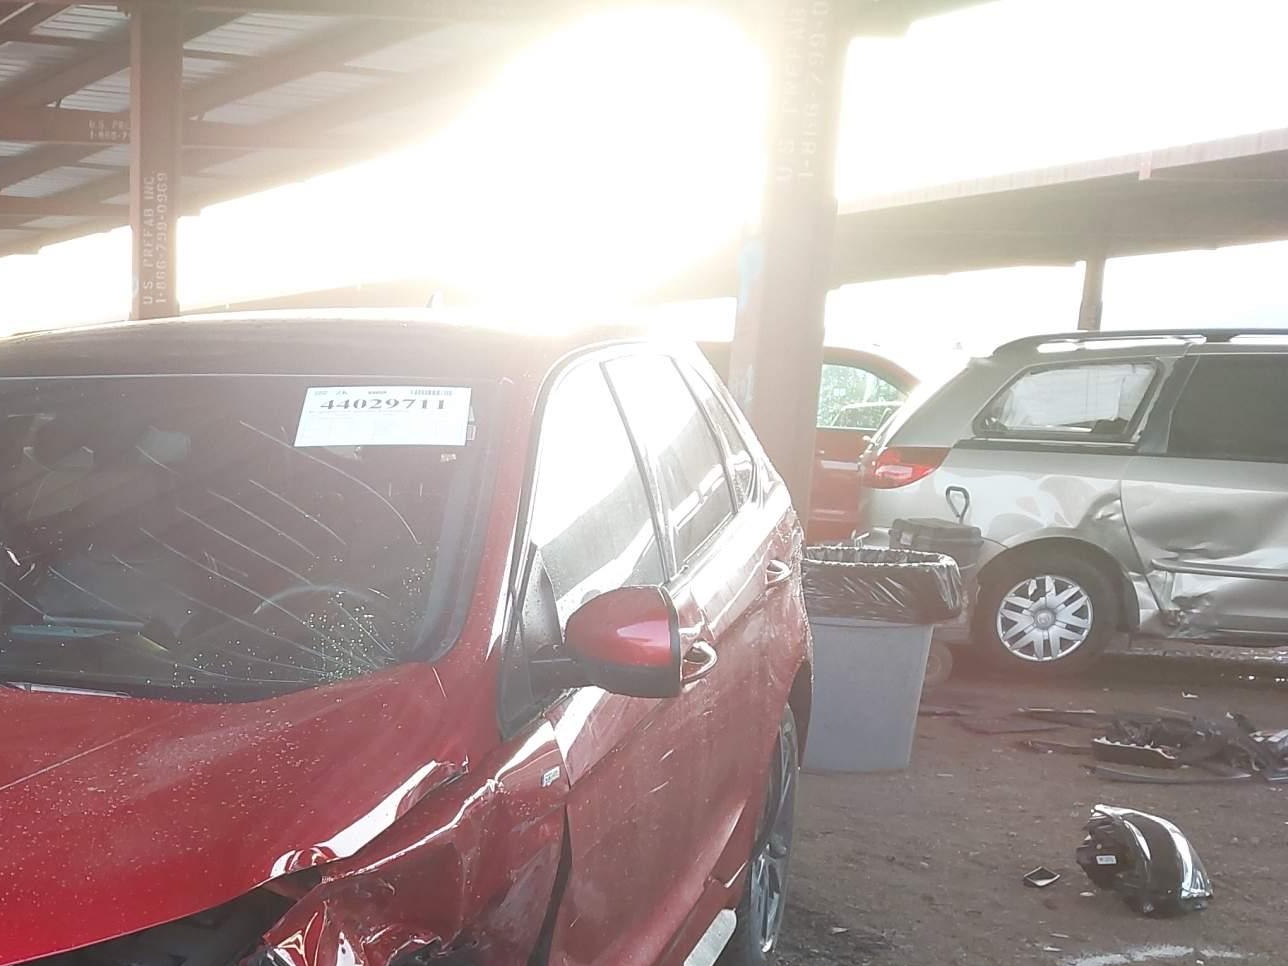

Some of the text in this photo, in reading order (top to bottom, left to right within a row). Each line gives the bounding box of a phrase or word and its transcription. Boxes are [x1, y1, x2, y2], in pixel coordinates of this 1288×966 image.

[143, 207, 154, 269] PREFAB
[155, 171, 168, 304] 1-866-799-0969
[320, 399, 445, 410] 44029711
